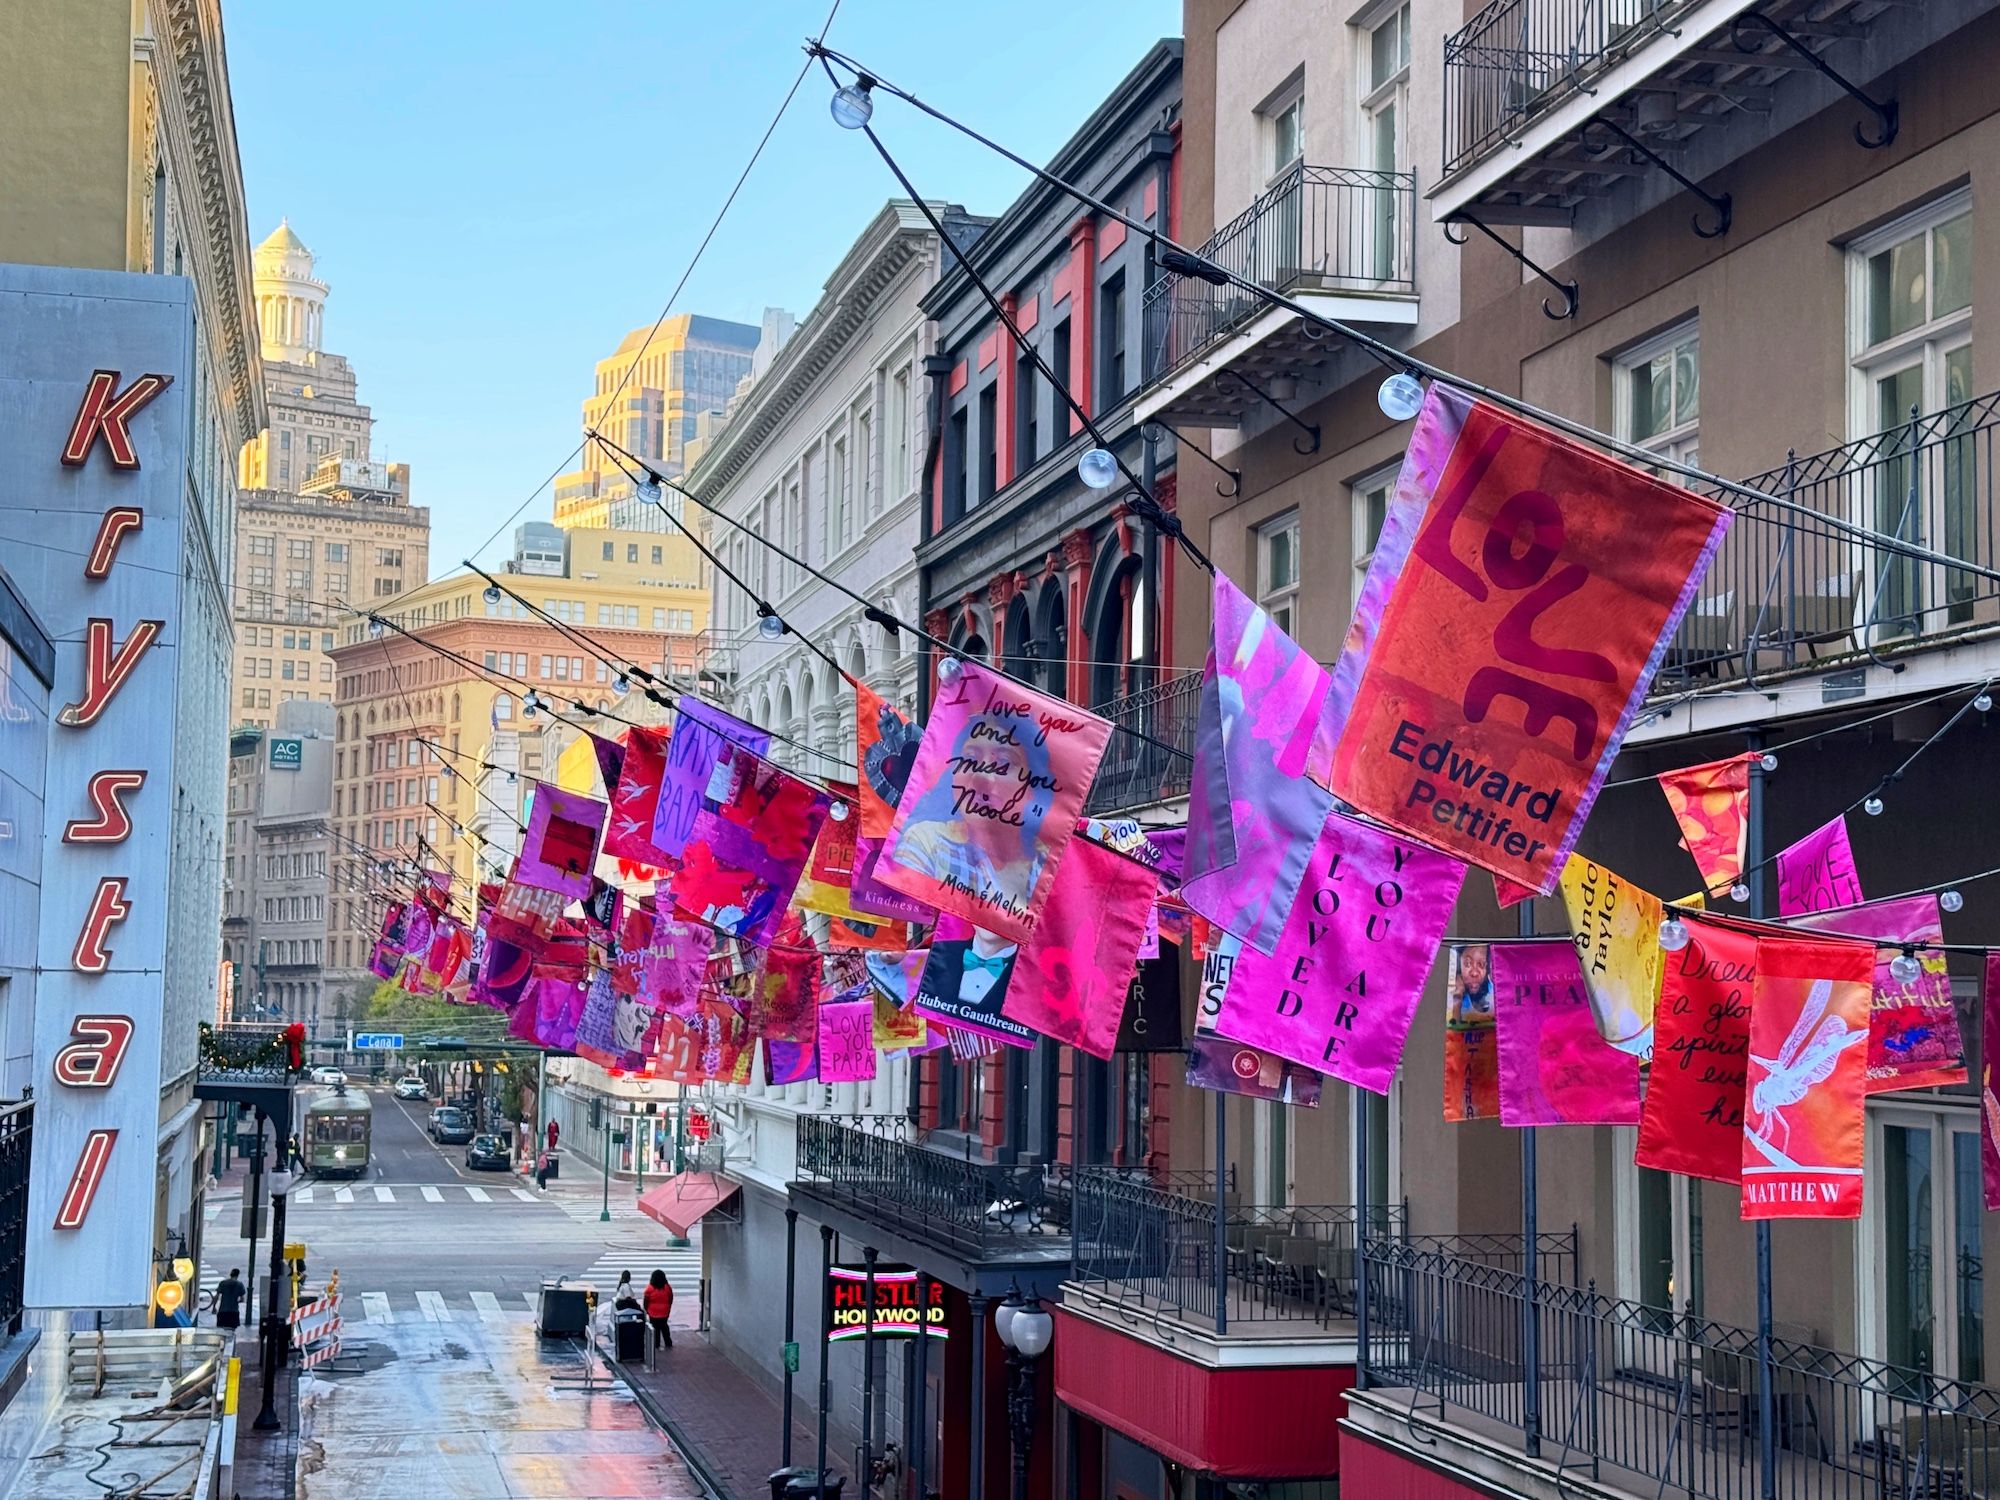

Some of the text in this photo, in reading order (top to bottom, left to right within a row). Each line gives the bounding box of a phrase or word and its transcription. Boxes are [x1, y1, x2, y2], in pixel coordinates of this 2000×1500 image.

[1413, 423, 1618, 763] LOVE
[945, 674, 1085, 747] I love you
[274, 742, 298, 755] AC
[970, 721, 1020, 747] and
[946, 756, 1063, 803] miss you
[1389, 719, 1564, 824] Edward
[54, 368, 174, 1230] Krystal
[655, 774, 700, 842] BAD
[951, 785, 1025, 827] Nicole
[1405, 778, 1546, 863] Pettifer
[1111, 821, 1137, 842] YOU
[1788, 841, 1850, 905] LOVE
[938, 873, 1036, 930] Mom & Melvin
[1275, 853, 1345, 1018] LOVED
[1591, 873, 1618, 977] Taylor
[1205, 951, 1234, 985] NE
[1322, 845, 1414, 1065] YOU ARE
[830, 1013, 873, 1035] LOVE
[917, 991, 1029, 1037] Hubert Gauthreaux
[1673, 995, 1693, 1016] a
[369, 1034, 395, 1048] Canal
[832, 1050, 876, 1072] PAPA
[842, 1033, 874, 1052] YOU
[1747, 1181, 1841, 1204] MATTHEW
